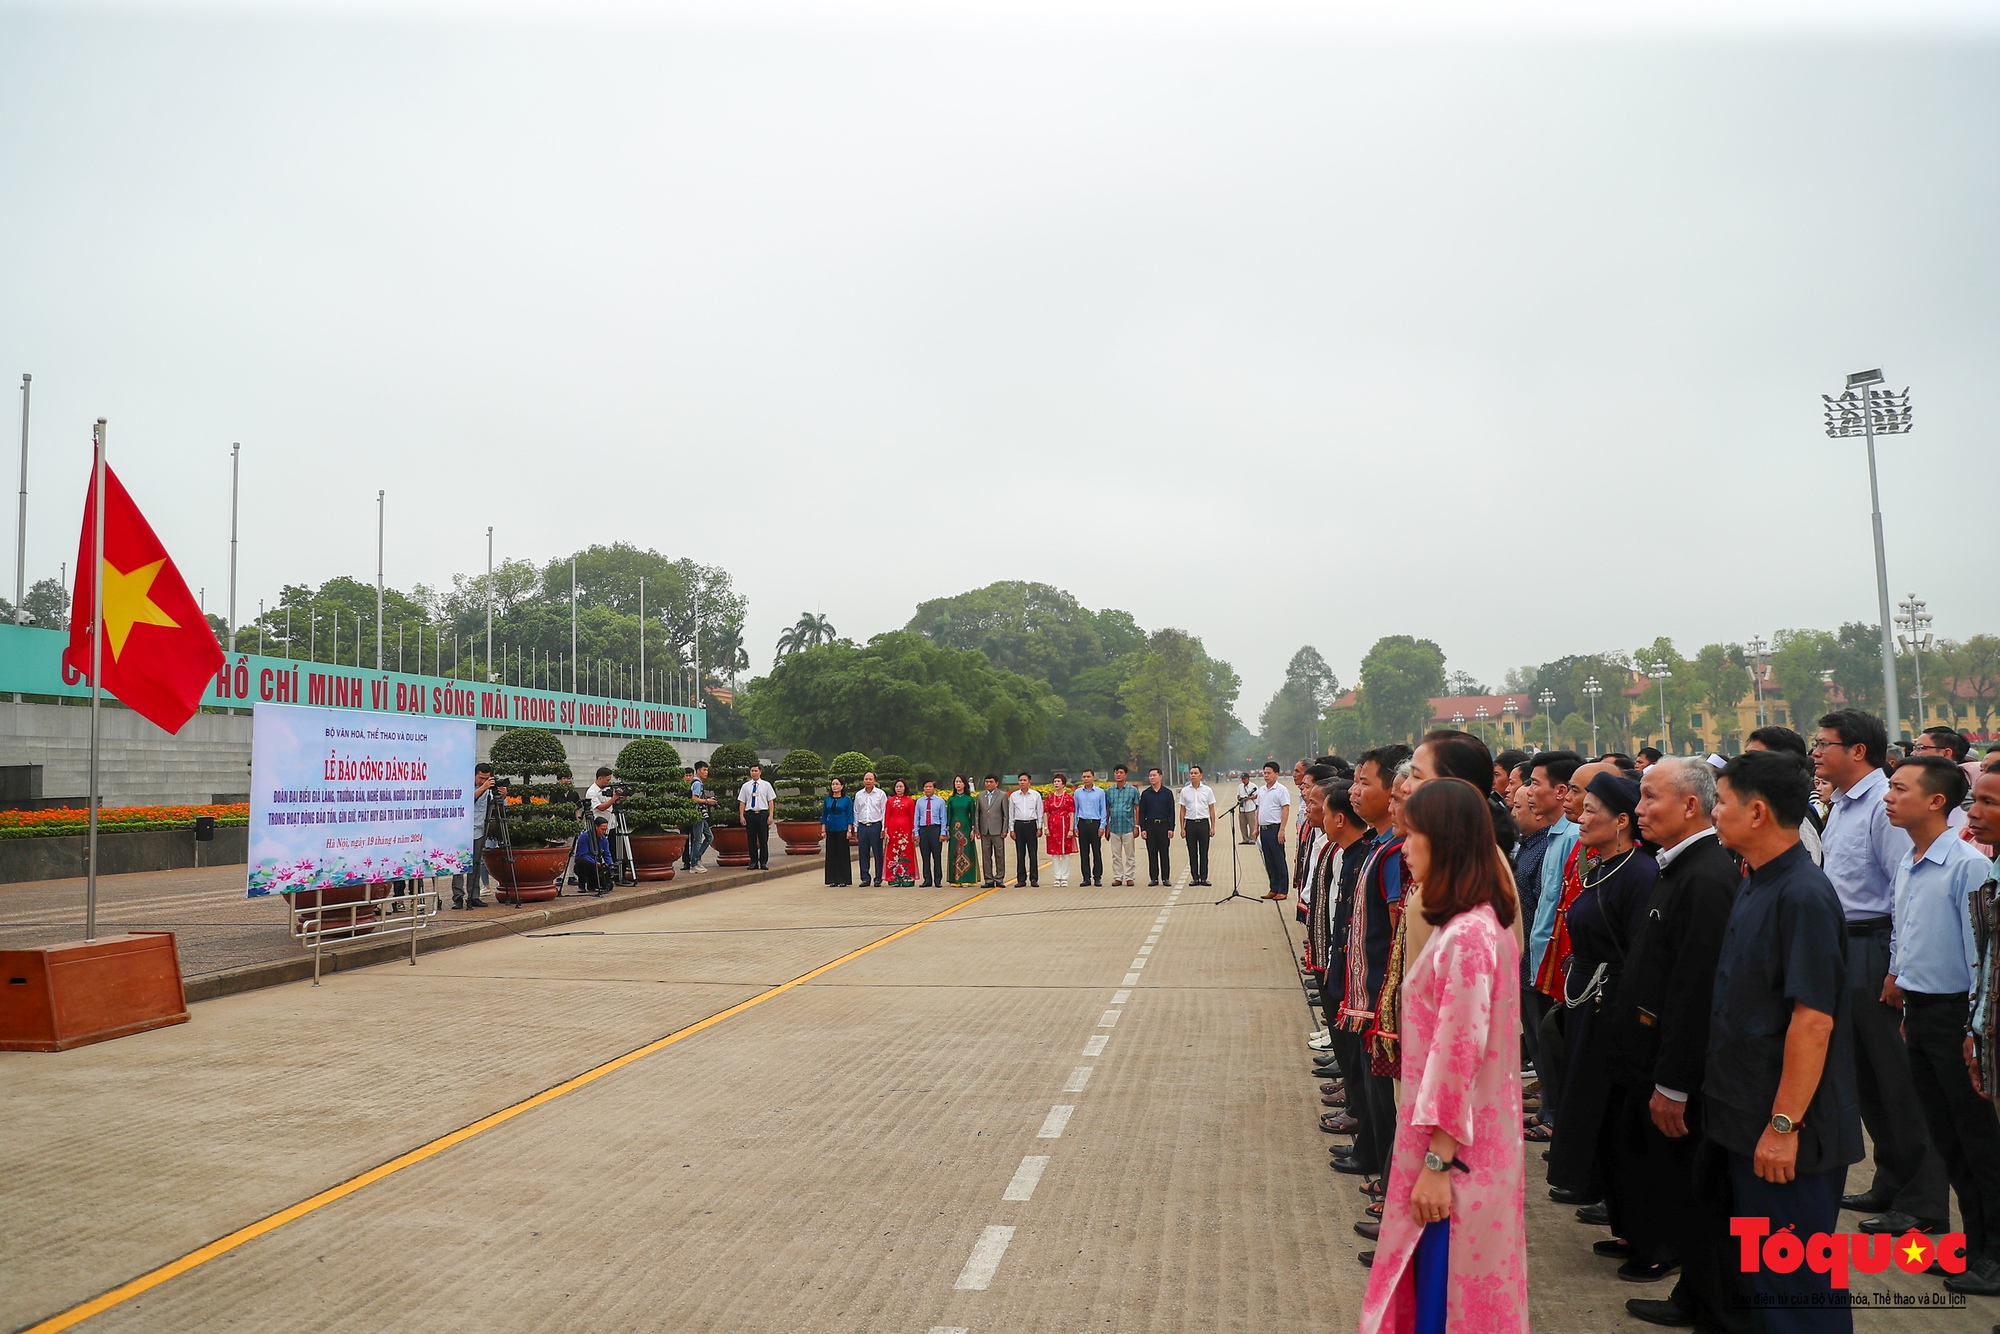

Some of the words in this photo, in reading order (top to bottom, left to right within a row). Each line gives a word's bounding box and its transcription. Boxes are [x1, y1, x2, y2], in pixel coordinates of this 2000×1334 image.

[216, 655, 249, 699] HỒ
[260, 664, 299, 703] CHÍ
[308, 673, 363, 708] MINH
[371, 675, 389, 710] VĨ
[396, 682, 425, 715] ĐẠI
[432, 681, 475, 716] SỐNG
[481, 688, 508, 719] MÃI
[514, 695, 555, 723] TRONG
[560, 698, 577, 728] SỰ
[579, 701, 618, 731] NGHIỆP
[622, 701, 641, 729] CỦA
[644, 706, 674, 731] CHÚNG
[677, 713, 687, 732] TA
[325, 727, 335, 739] BỘ
[336, 728, 349, 738] VĂN
[367, 728, 379, 739] THỂ
[380, 731, 396, 740] THAO
[397, 731, 405, 740] VÀ
[406, 733, 414, 741] DU
[415, 734, 428, 743] LỊCH
[324, 749, 336, 780] LỄ
[338, 754, 357, 781] BÁO
[359, 755, 383, 781] CÔNG
[385, 756, 409, 781] DÂNG
[411, 757, 427, 780] BÁC
[326, 838, 335, 849] Hà
[367, 836, 375, 846] 19
[375, 835, 392, 847] tháng
[392, 835, 397, 844] 4
[397, 834, 410, 844] năm
[410, 833, 423, 843] 2024
